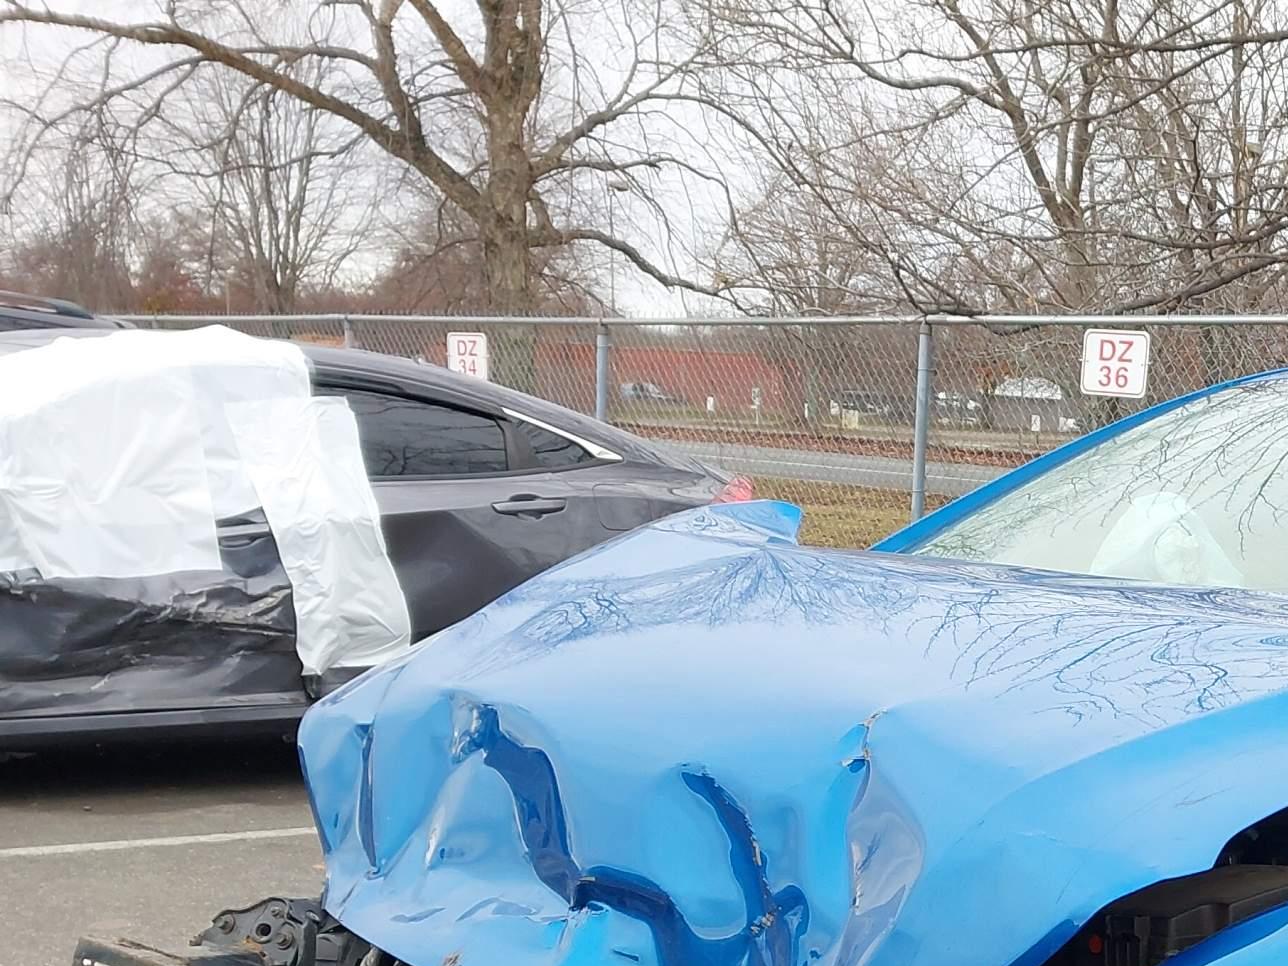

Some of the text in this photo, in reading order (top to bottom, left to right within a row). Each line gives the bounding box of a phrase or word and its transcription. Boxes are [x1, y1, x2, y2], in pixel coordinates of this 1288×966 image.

[457, 340, 478, 357] DZ
[1099, 339, 1134, 363] DZ
[458, 358, 477, 375] 34
[1098, 365, 1129, 388] 36
